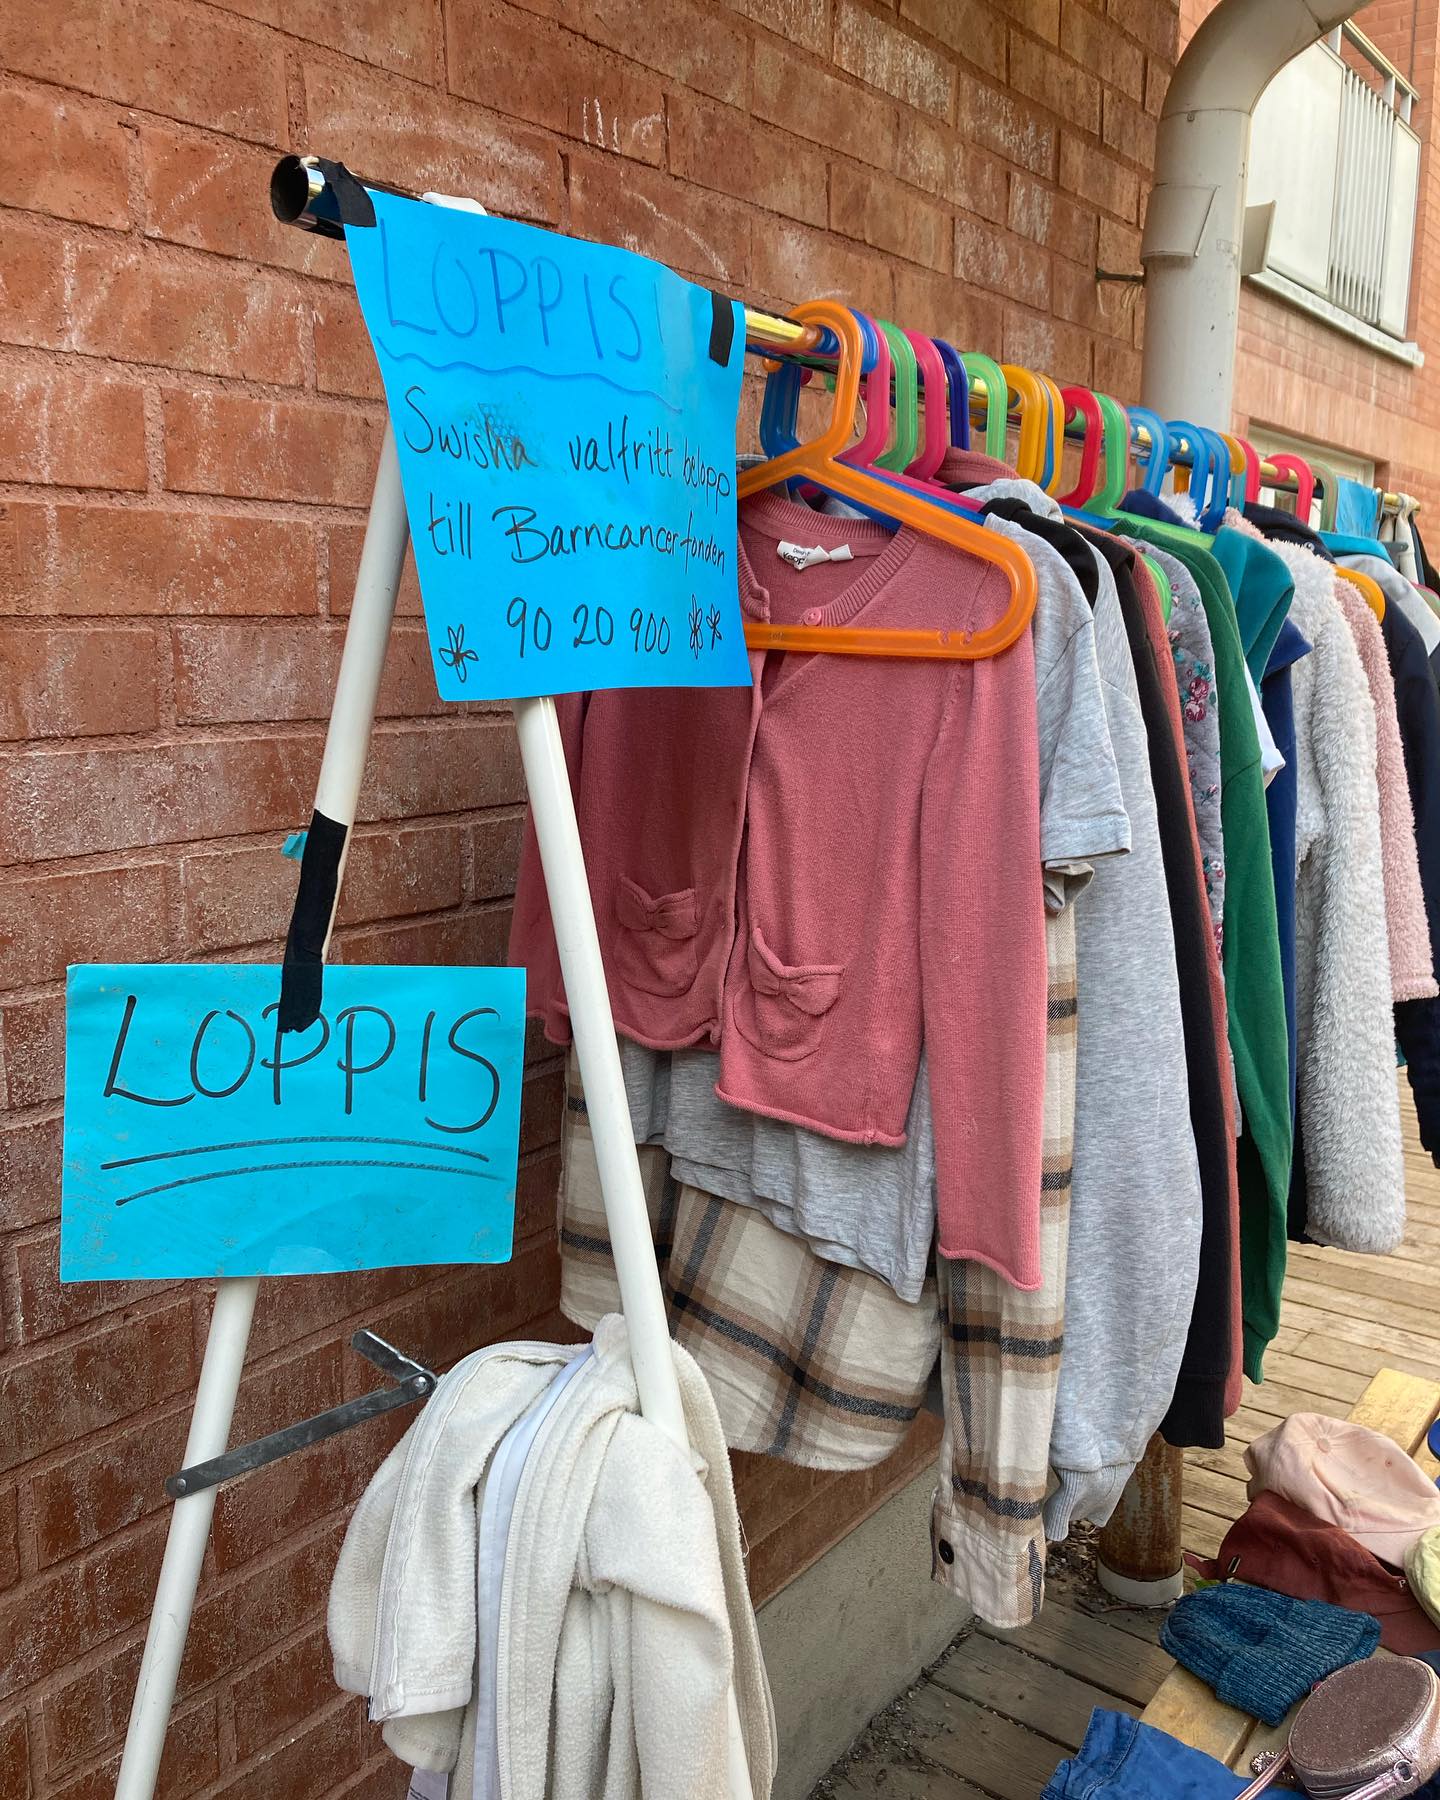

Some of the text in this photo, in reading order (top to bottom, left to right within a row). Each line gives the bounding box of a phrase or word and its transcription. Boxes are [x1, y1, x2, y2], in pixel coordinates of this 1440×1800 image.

[568, 414, 675, 485] valfritt
[682, 435, 731, 515] belopp
[427, 492, 473, 561] till
[506, 596, 671, 659] 90 20 900
[103, 995, 500, 1133] LOPPIS
